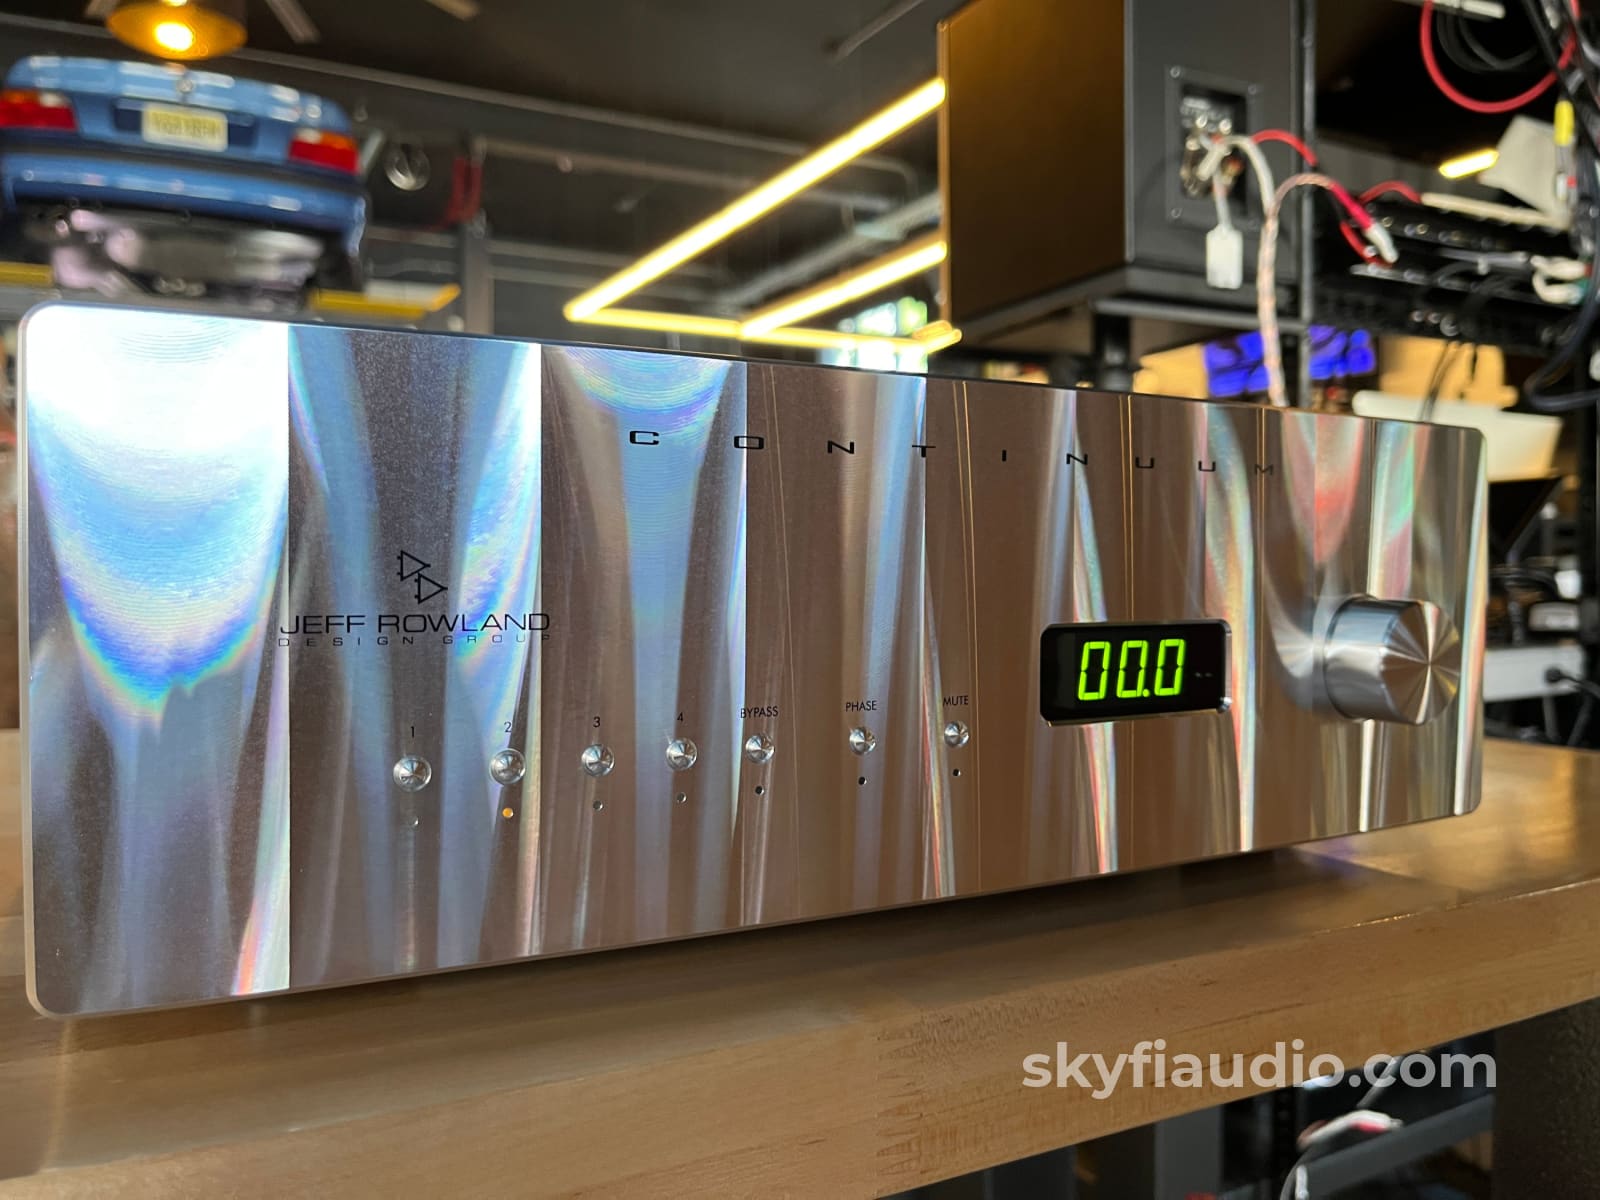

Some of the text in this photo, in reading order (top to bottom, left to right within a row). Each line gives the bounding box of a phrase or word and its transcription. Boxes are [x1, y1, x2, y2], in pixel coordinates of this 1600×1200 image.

[629, 430, 1274, 476] CONTINUUM
[280, 613, 550, 634] JEFF ROWLAND
[278, 634, 550, 647] DESIGN GROUP
[1077, 638, 1187, 701] 00.0
[845, 700, 877, 713] PHASE
[942, 695, 969, 707] MUTE
[676, 712, 684, 723] 4
[740, 705, 779, 719] BYPASS
[503, 721, 512, 733] 2
[592, 716, 601, 728] 3
